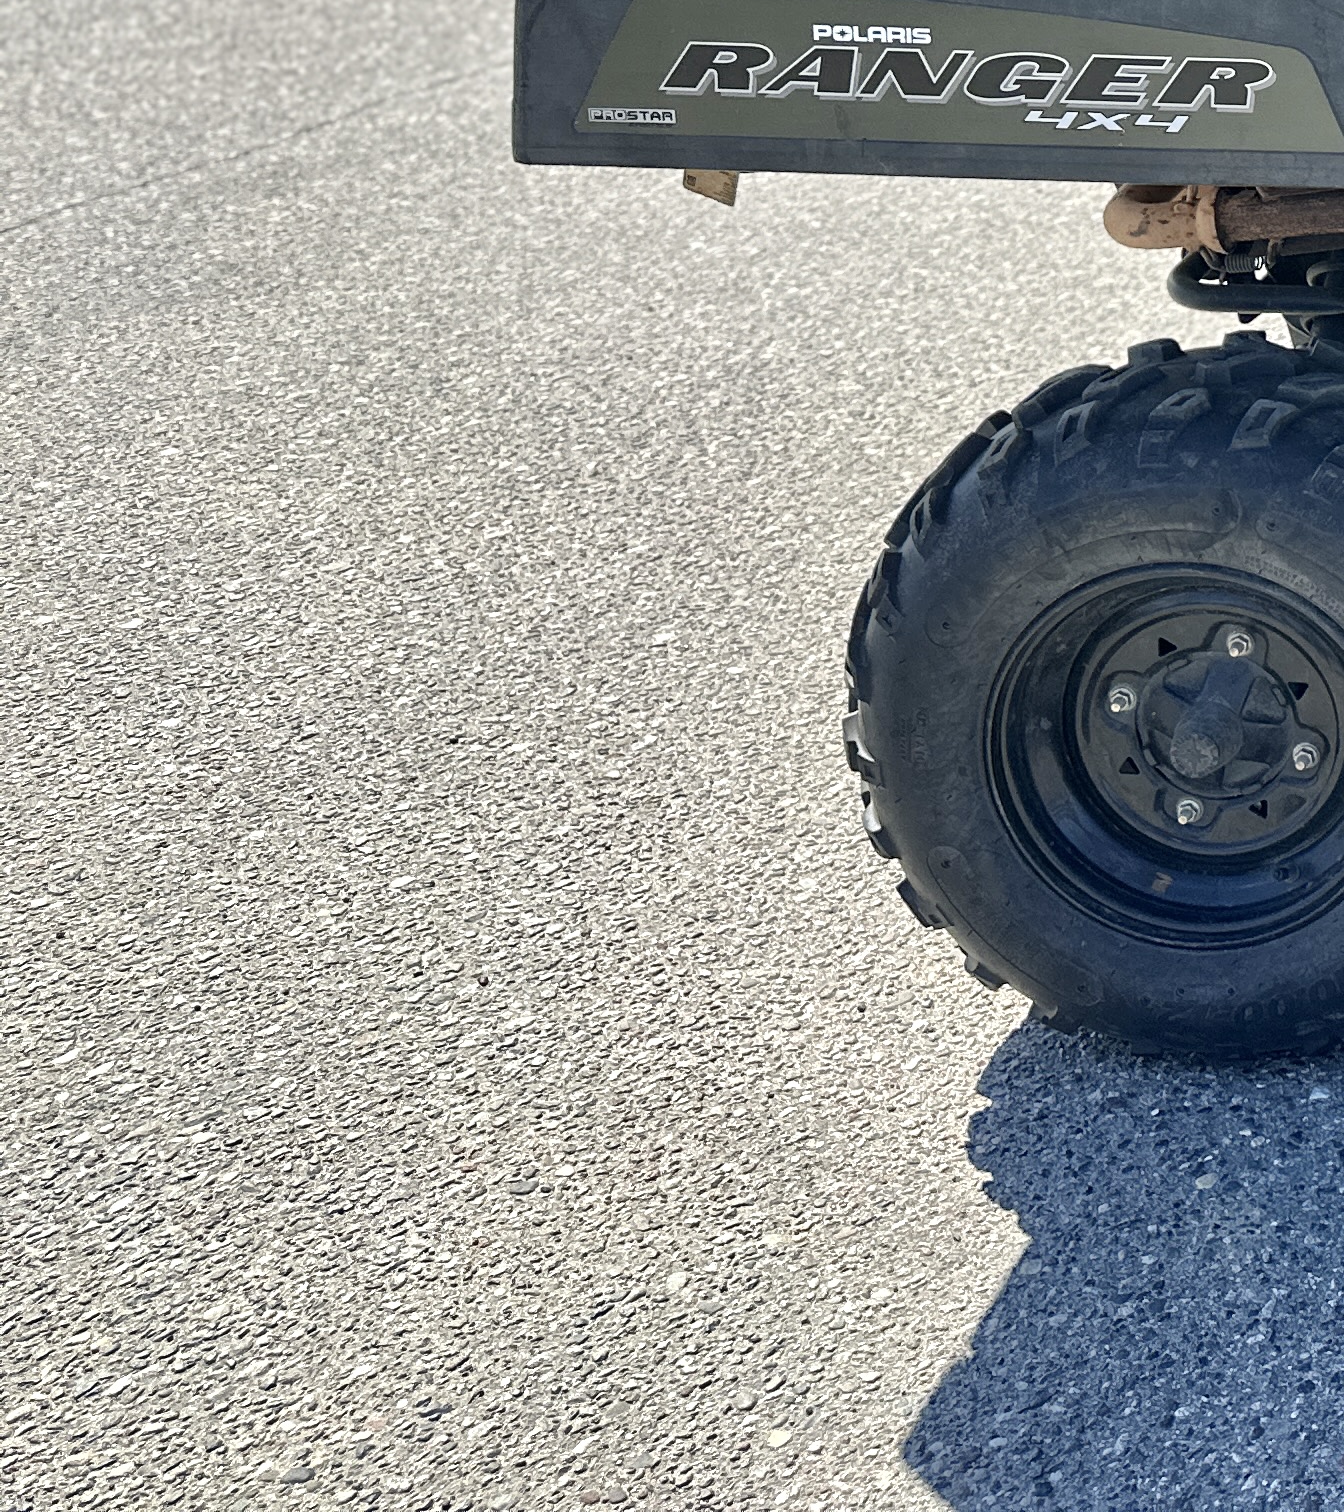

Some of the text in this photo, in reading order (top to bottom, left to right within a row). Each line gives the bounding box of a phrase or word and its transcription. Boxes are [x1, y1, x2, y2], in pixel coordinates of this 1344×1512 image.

[813, 24, 932, 44] POLARIS
[659, 40, 1276, 113] RANGER
[590, 108, 675, 122] PROSTAR
